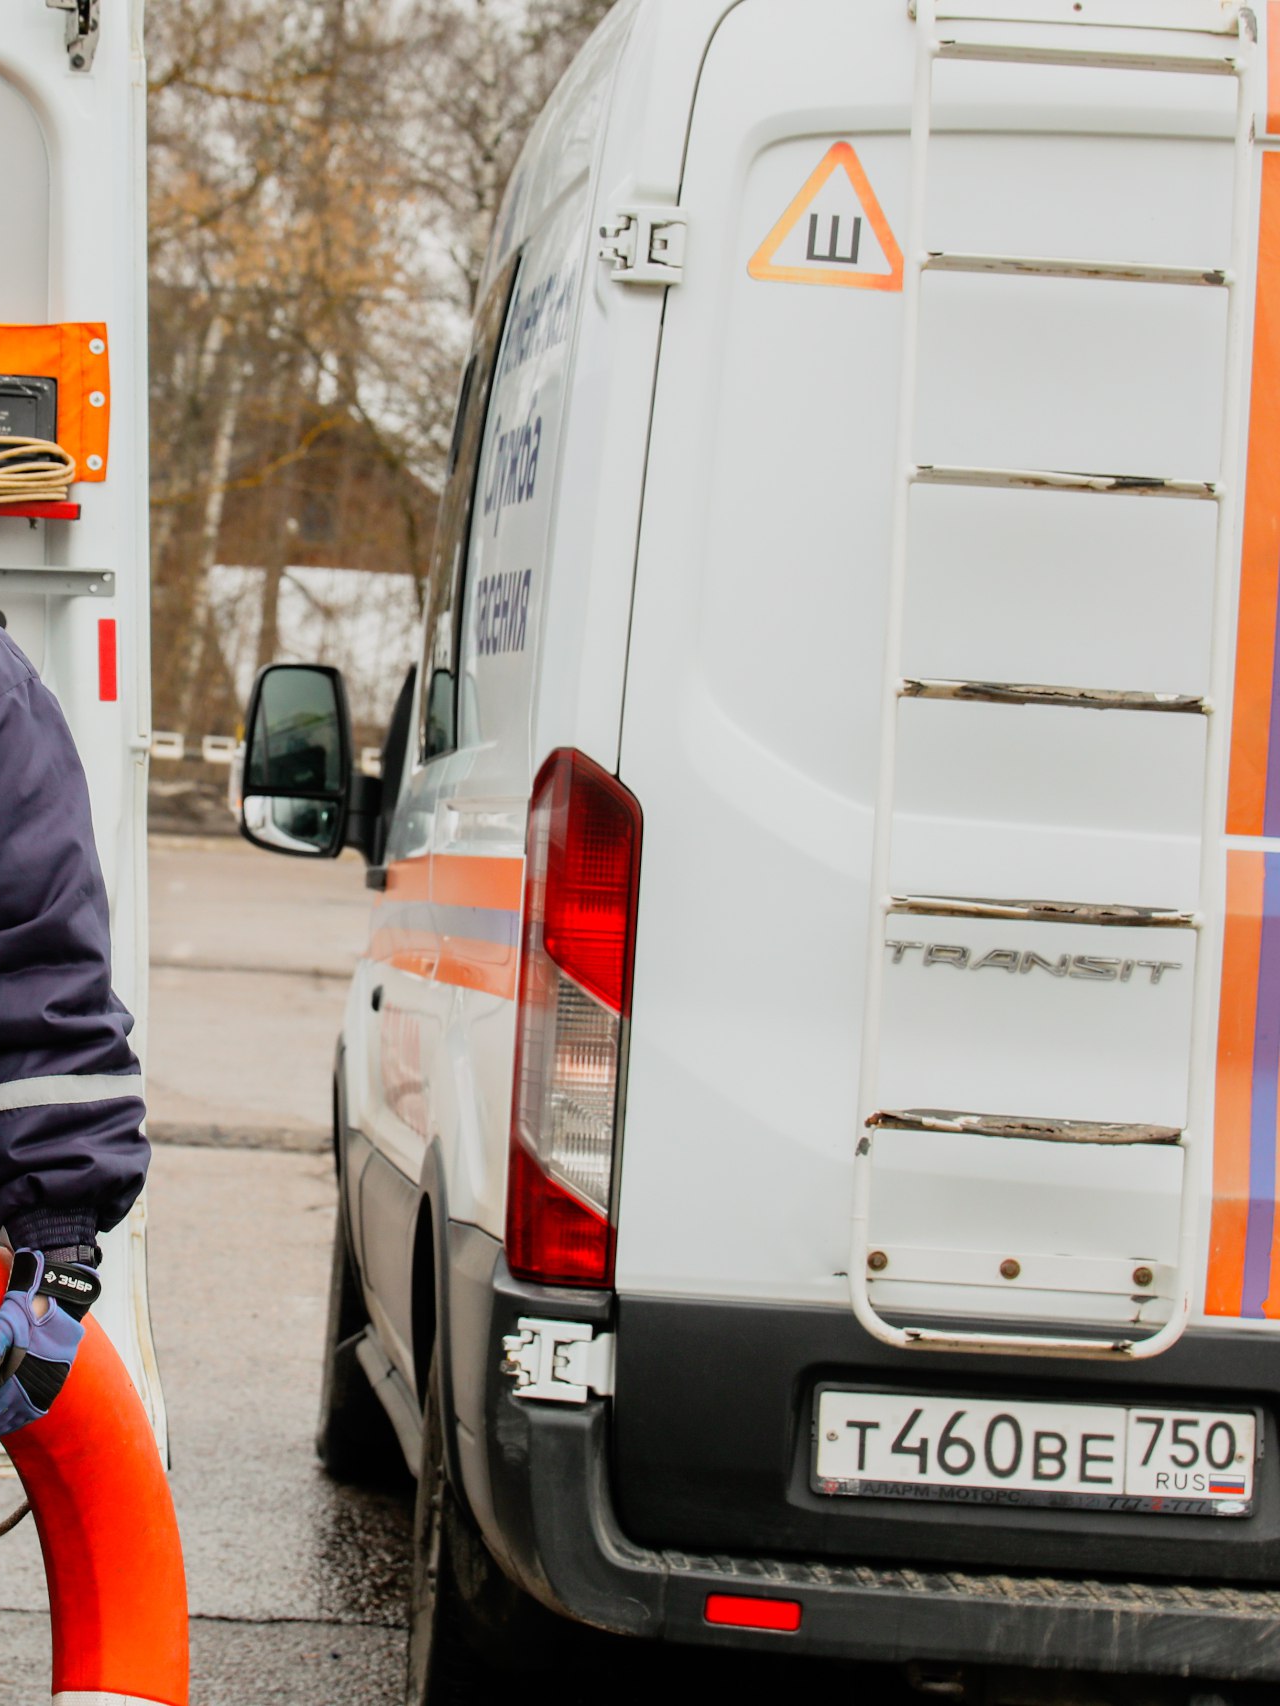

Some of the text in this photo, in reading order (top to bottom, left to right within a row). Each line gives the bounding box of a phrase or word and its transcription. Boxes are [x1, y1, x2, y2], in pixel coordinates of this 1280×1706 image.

[806, 213, 862, 265] Ш
[477, 569, 533, 655] асения
[885, 939, 1183, 985] TRANSIT
[58, 1274, 93, 1293] ЗУБР
[845, 1408, 1237, 1485] Т460ВЕ 750
[862, 1482, 1021, 1504] АЛАРМ-МОТОРС
[1106, 1495, 1207, 1512] 777-2-777
[1155, 1472, 1206, 1492] RUS
